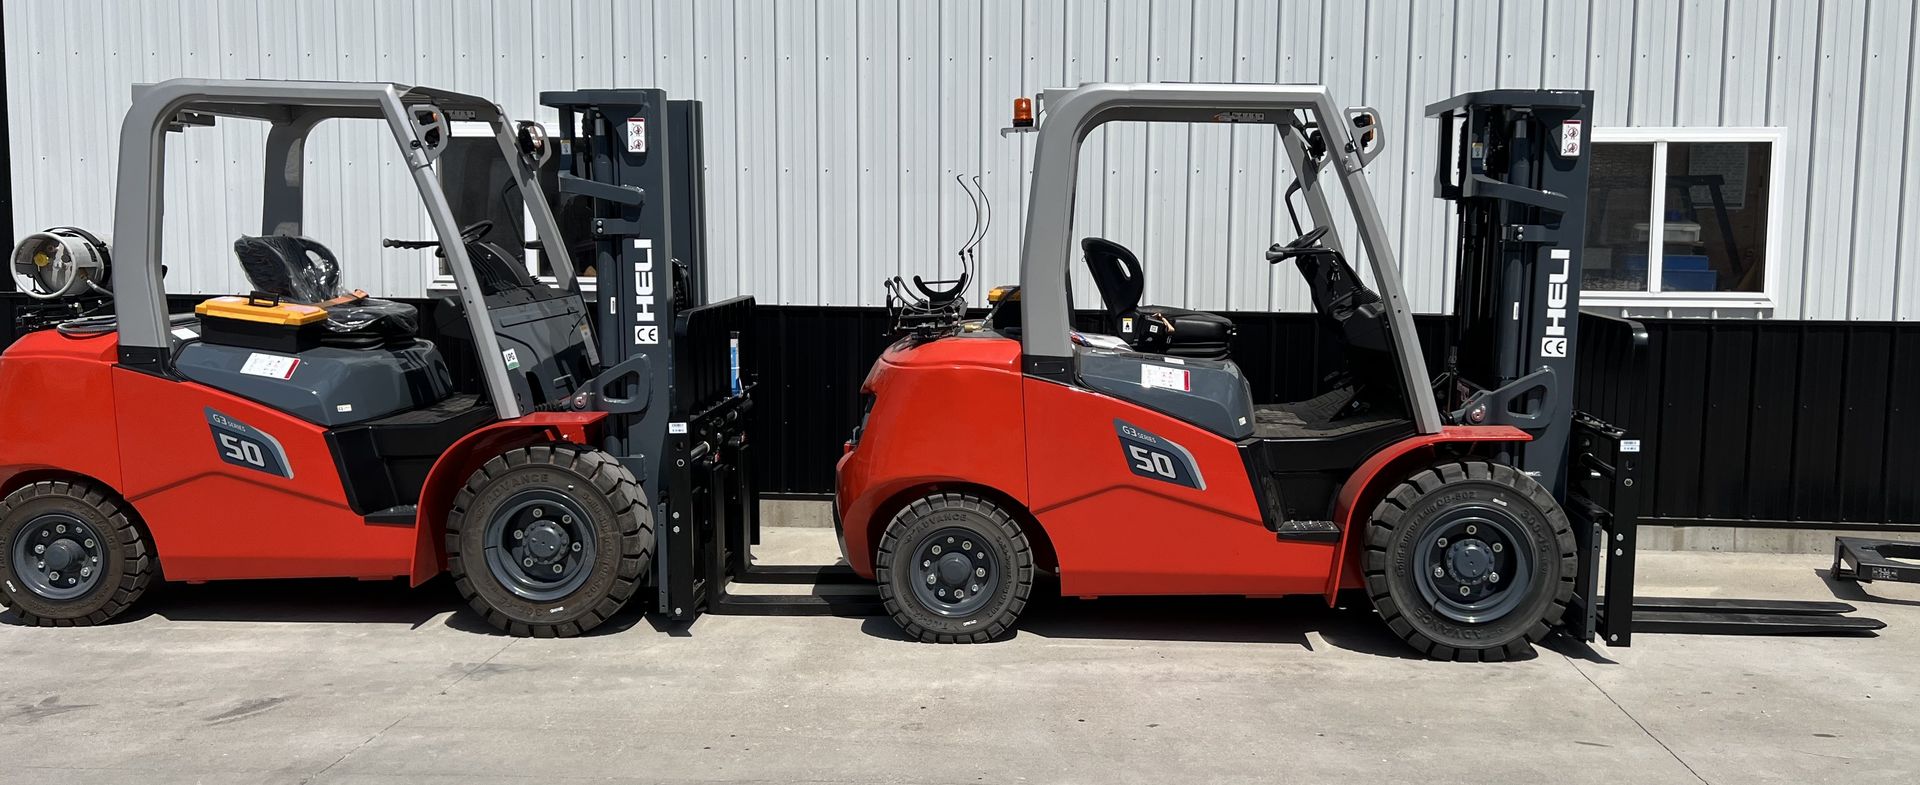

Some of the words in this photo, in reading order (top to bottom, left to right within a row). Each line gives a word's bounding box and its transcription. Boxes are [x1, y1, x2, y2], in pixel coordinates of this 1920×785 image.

[634, 239, 655, 321] HELI
[1545, 249, 1570, 336] HELI
[637, 328, 657, 342] CE
[1544, 340, 1565, 354] CE
[506, 352, 516, 362] LPG
[212, 413, 227, 425] G3
[1122, 425, 1137, 437] G3
[1137, 432, 1157, 444] SERIES
[219, 432, 265, 467] 50
[1128, 444, 1177, 479] 50
